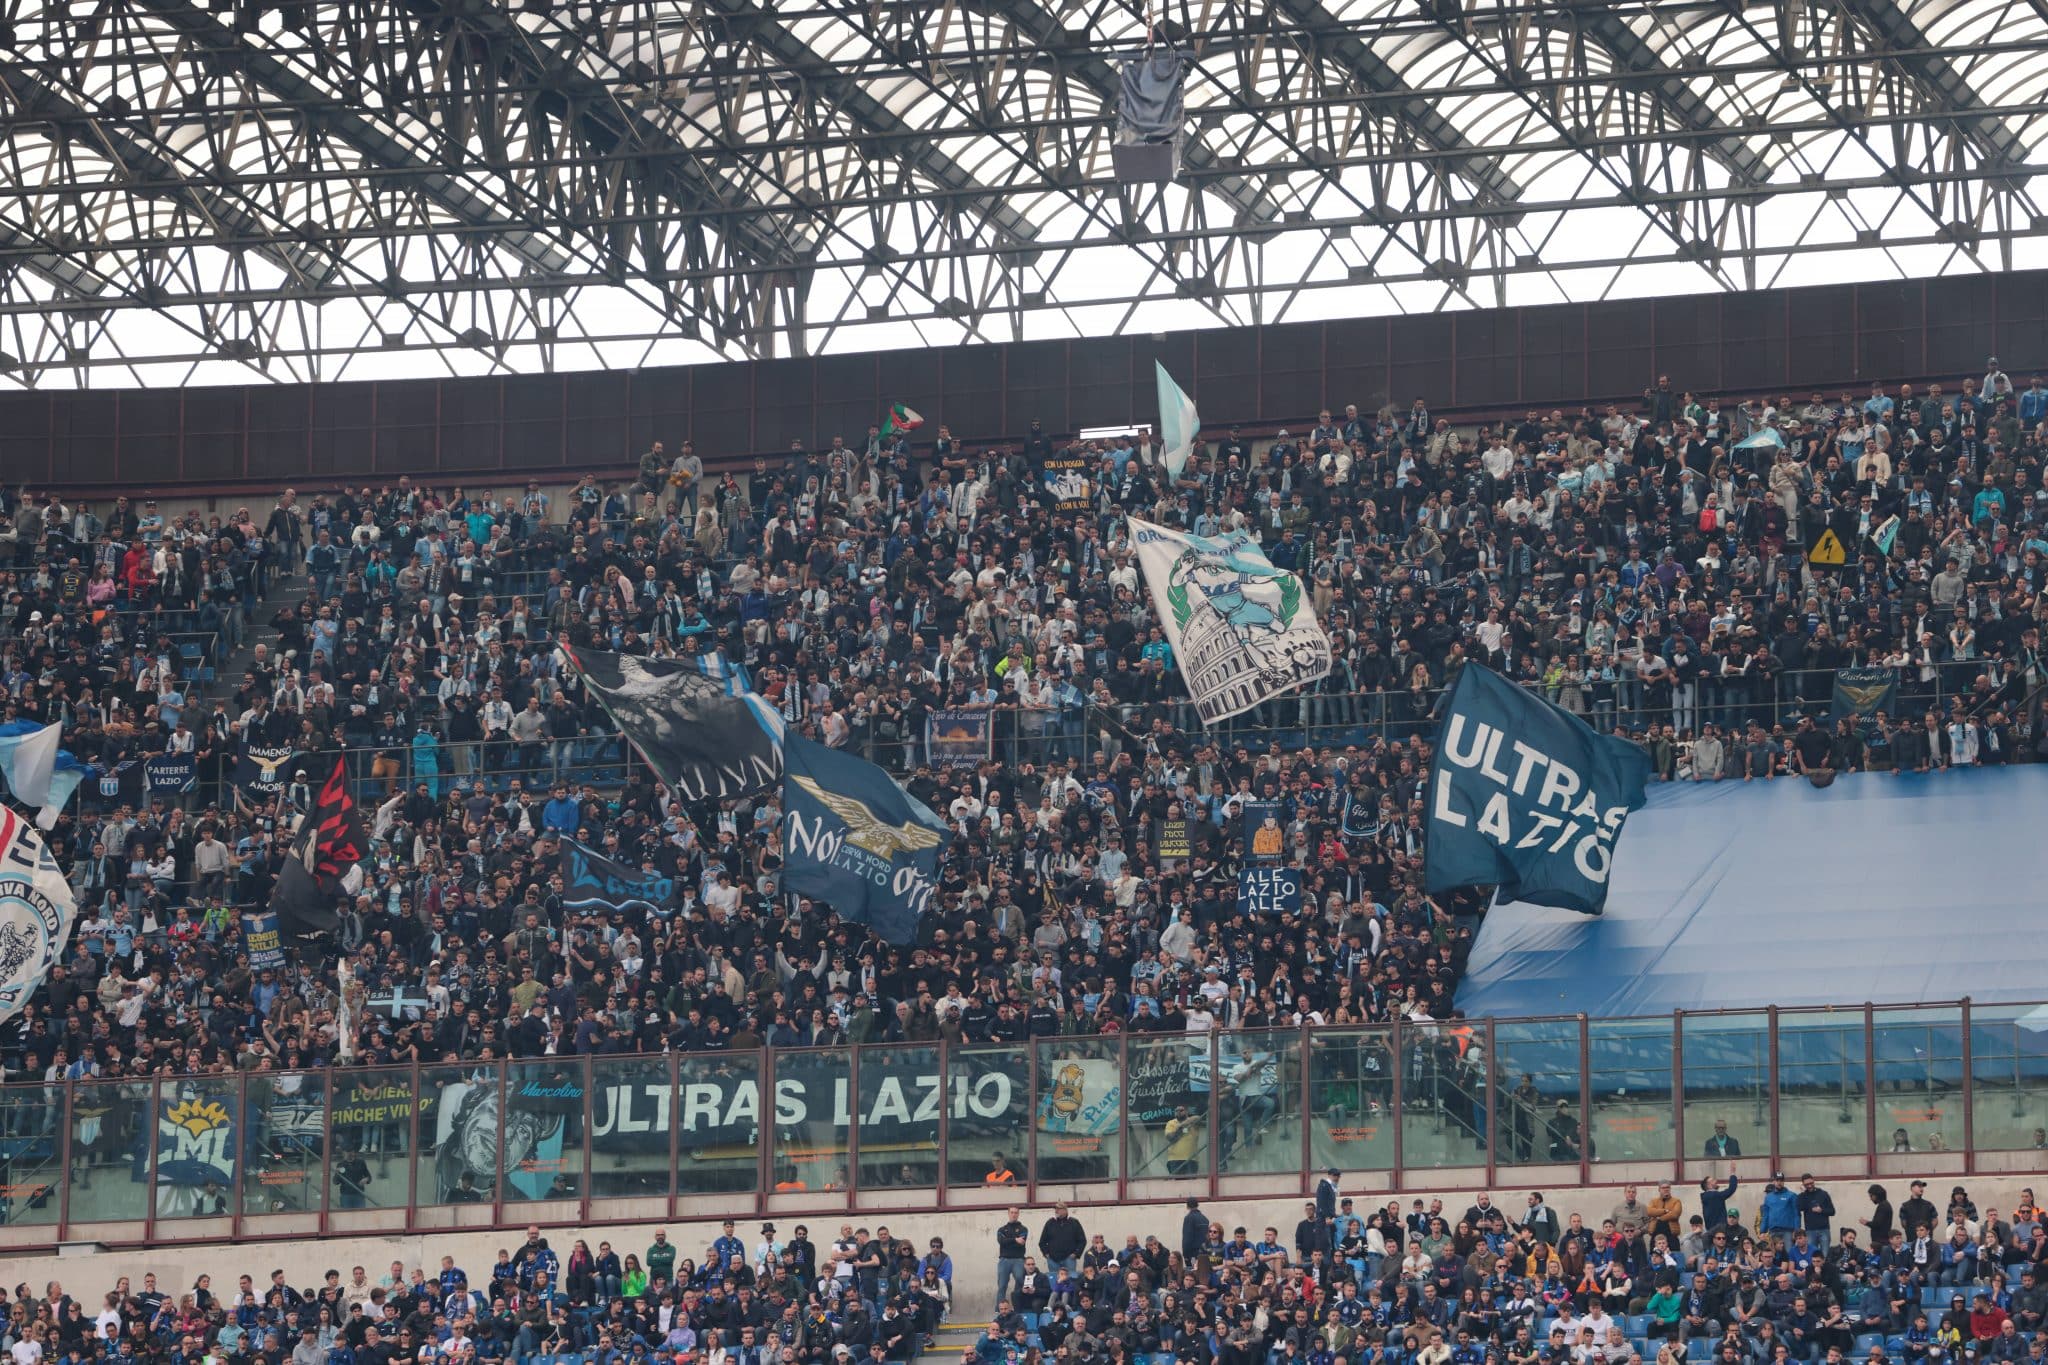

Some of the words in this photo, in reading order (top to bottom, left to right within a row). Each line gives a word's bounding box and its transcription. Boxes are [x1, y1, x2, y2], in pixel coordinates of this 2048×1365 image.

[249, 745, 291, 757] IMMENSO
[148, 765, 190, 774] PARTERRE
[1445, 713, 1628, 841] ULTRAS
[155, 777, 181, 785] LAZIO
[249, 780, 284, 792] AMORE
[1163, 821, 1185, 829] LAZIO
[1435, 769, 1611, 883] LAZIO
[788, 810, 846, 864] Noi
[834, 854, 887, 886] LAZIO
[865, 855, 891, 873] NORD
[1246, 867, 1284, 883] ALE
[1238, 881, 1296, 900] LAZIO
[27, 893, 59, 930] NORD
[1248, 896, 1284, 912] ALE
[519, 1081, 583, 1098] Marcolino
[331, 1106, 387, 1125] FINCHE'
[390, 1098, 433, 1119] VIVO'
[582, 1079, 806, 1136] ULTRAS
[834, 1072, 1011, 1125] LAZIO
